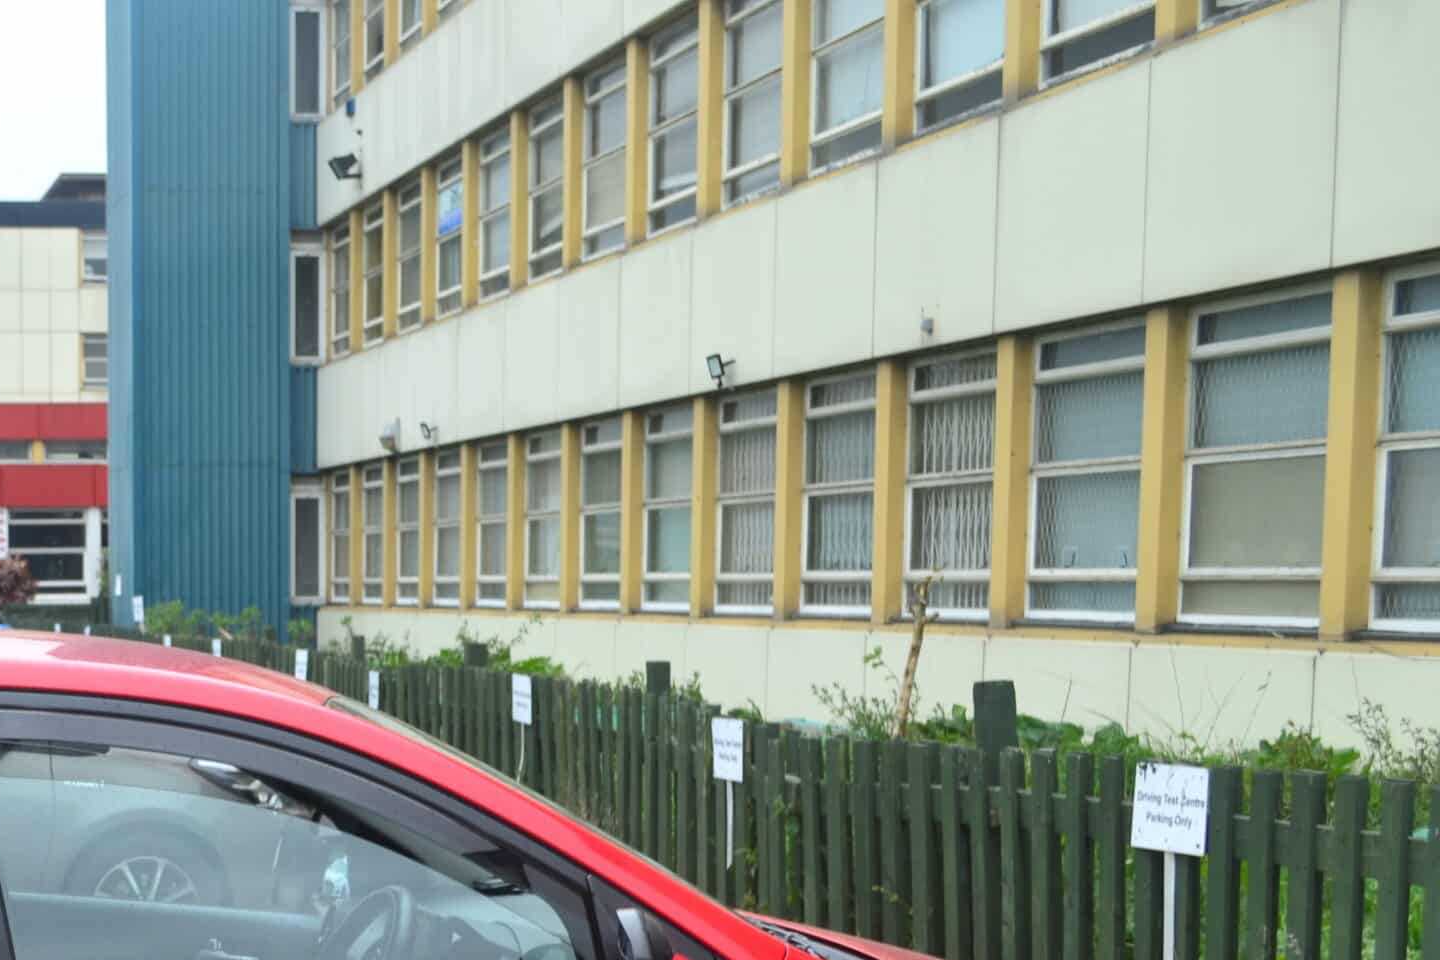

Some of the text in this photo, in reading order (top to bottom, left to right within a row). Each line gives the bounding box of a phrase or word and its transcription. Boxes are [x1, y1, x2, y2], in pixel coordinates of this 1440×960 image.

[1137, 790, 1162, 806] Driving
[1164, 793, 1179, 805] Test
[1146, 812, 1192, 830] Parking Only
